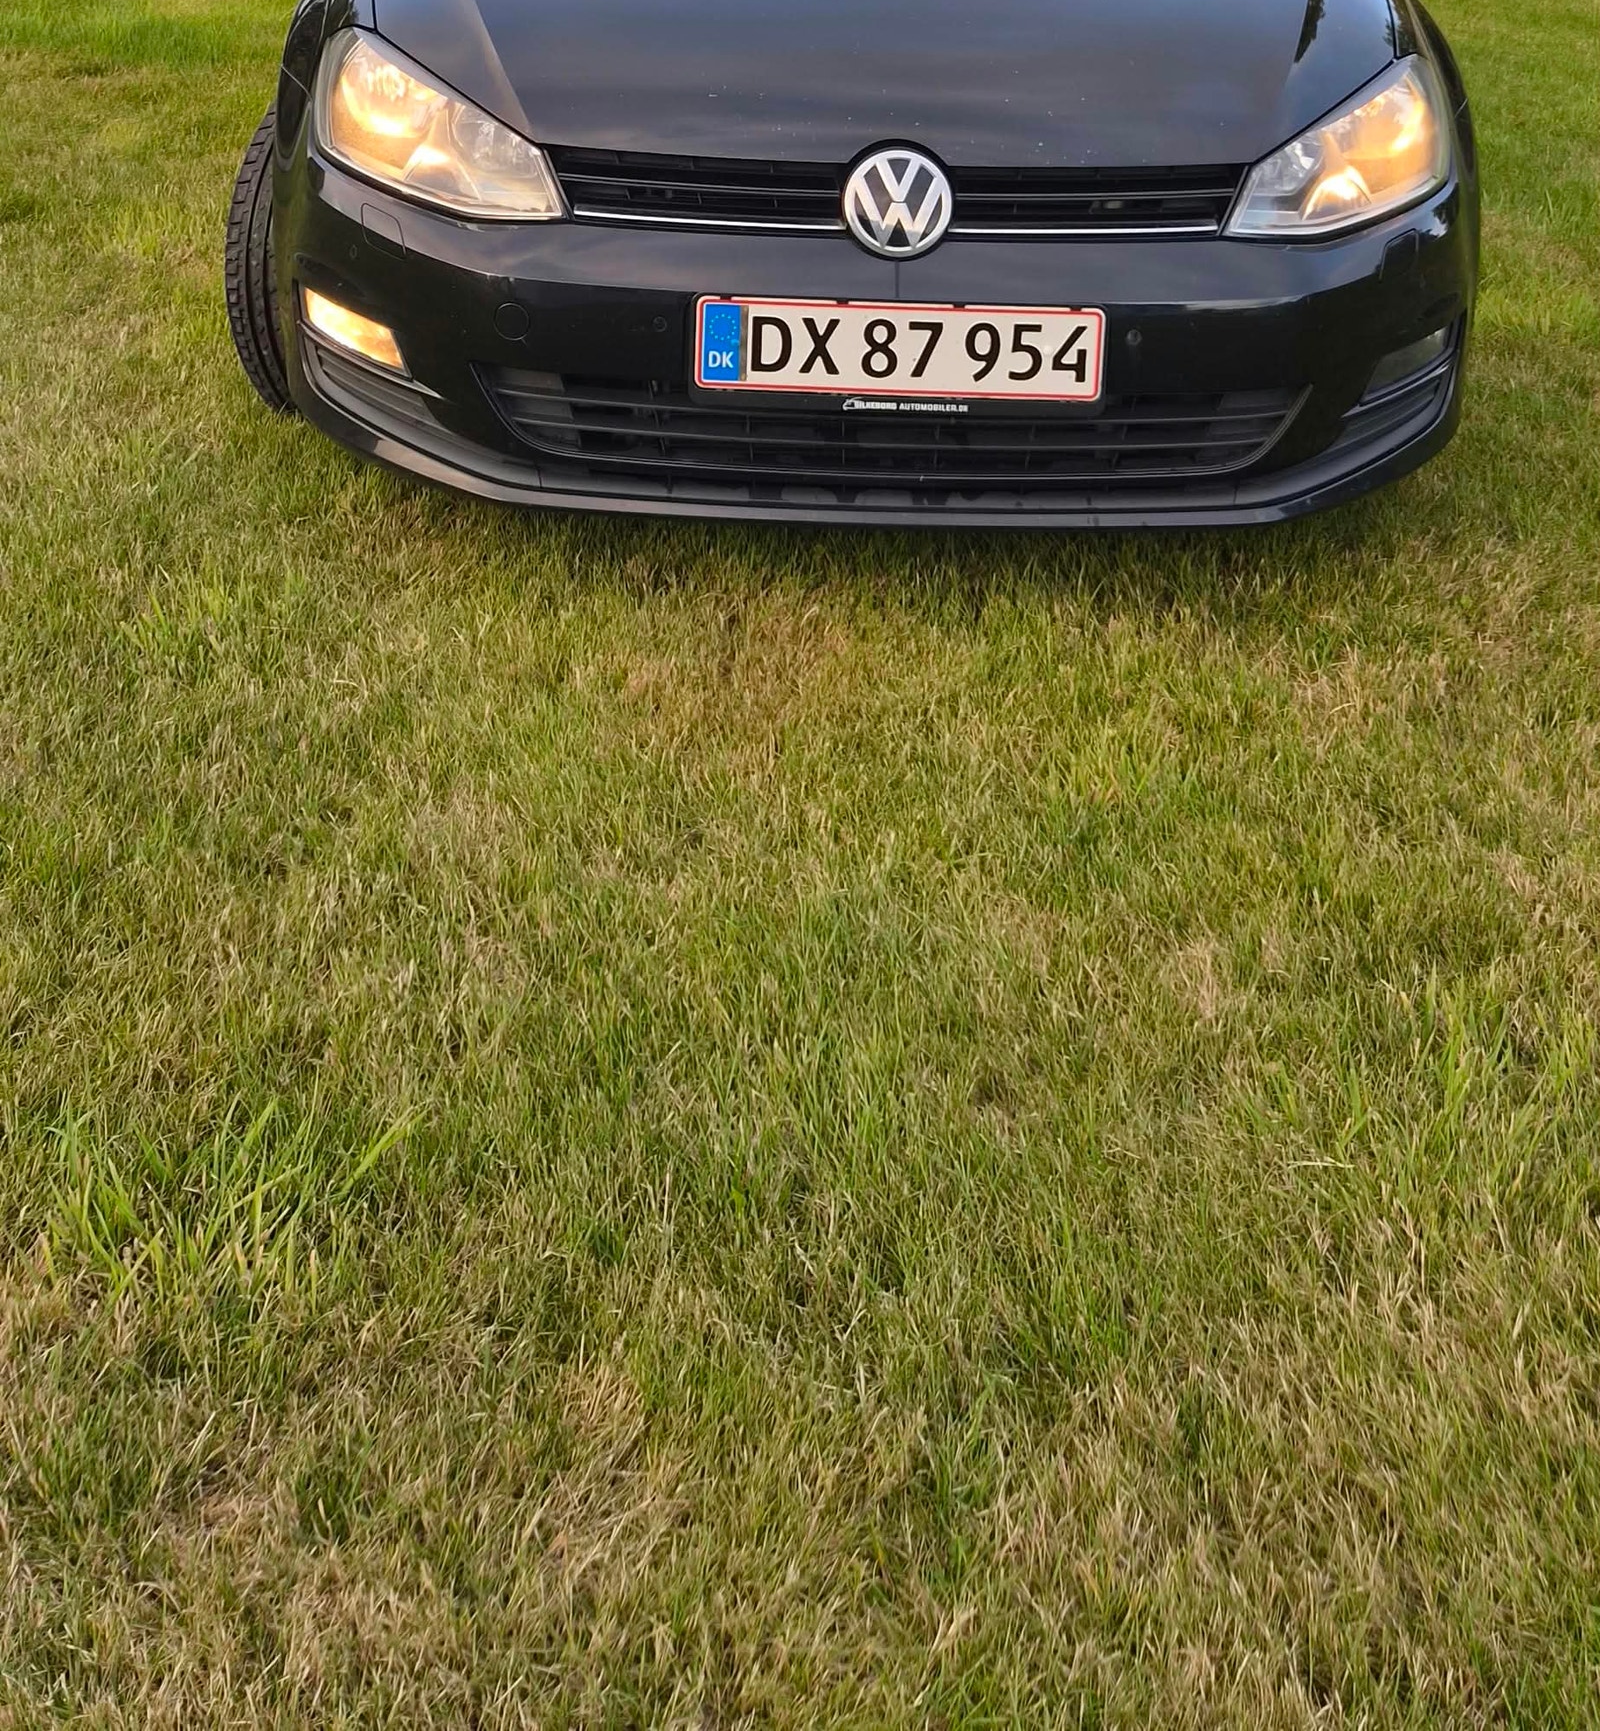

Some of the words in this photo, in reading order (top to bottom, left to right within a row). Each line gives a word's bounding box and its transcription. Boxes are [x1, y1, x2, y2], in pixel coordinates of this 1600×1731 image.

[849, 154, 947, 252] VW
[708, 351, 734, 368] DK
[751, 316, 840, 374] DX
[861, 319, 944, 378] 87
[965, 322, 1088, 382] 954
